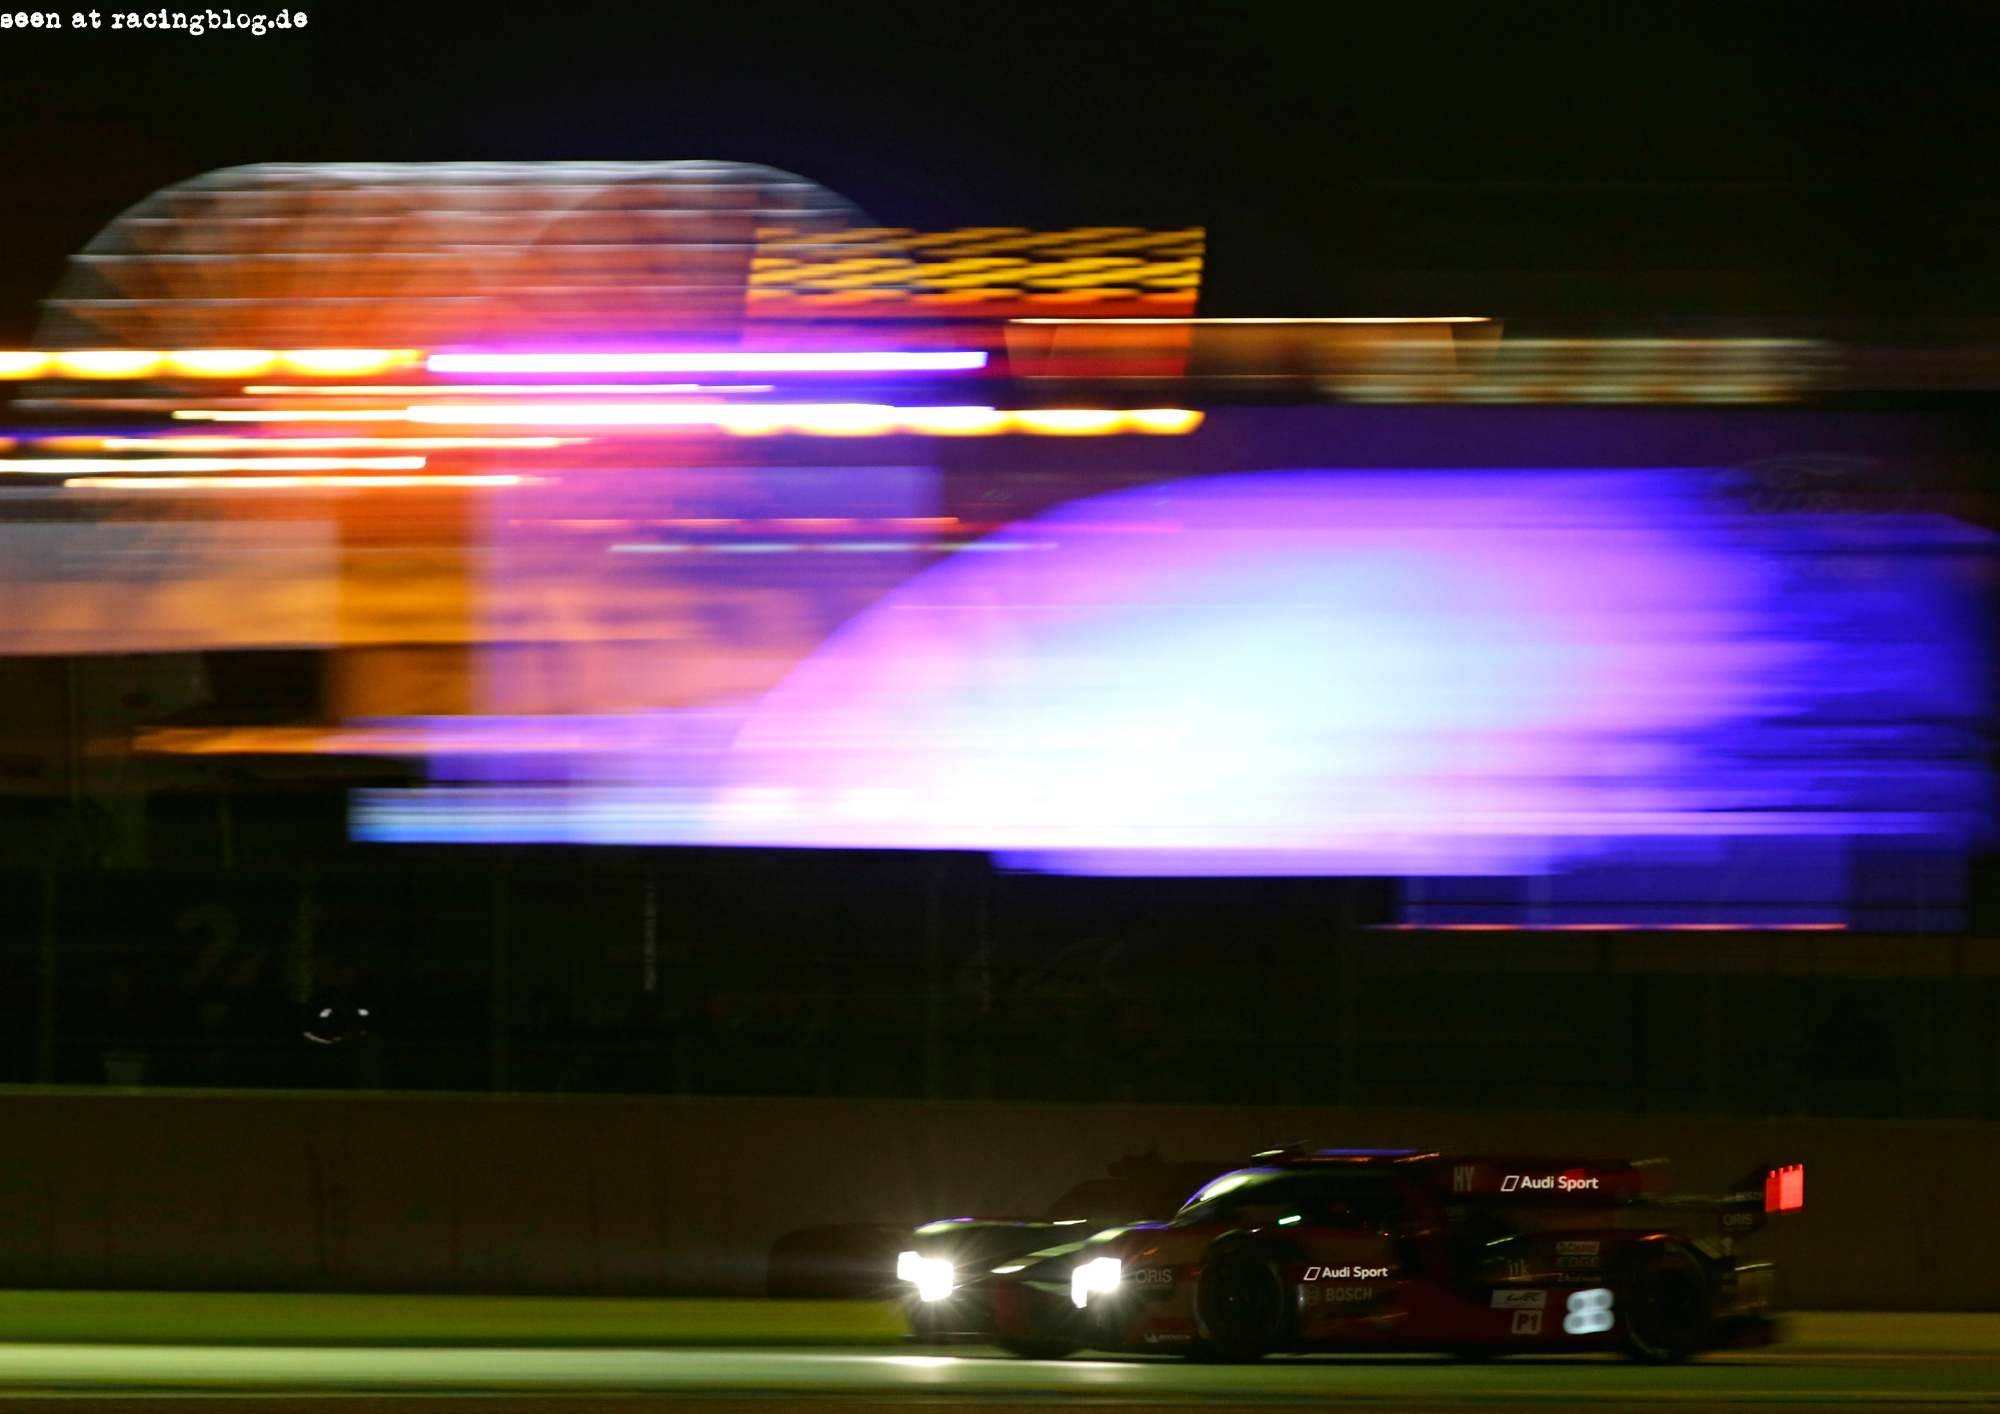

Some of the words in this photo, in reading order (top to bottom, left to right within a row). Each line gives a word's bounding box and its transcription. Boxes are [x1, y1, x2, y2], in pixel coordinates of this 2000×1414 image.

[1453, 1165, 1475, 1192] HY
[1519, 1175, 1554, 1190] Audi
[1557, 1175, 1600, 1192] Sport
[1135, 1268, 1173, 1284] ORIS
[1322, 1266, 1351, 1279] Audi
[1353, 1265, 1389, 1280] Sport
[1325, 1287, 1373, 1303] BOSCH
